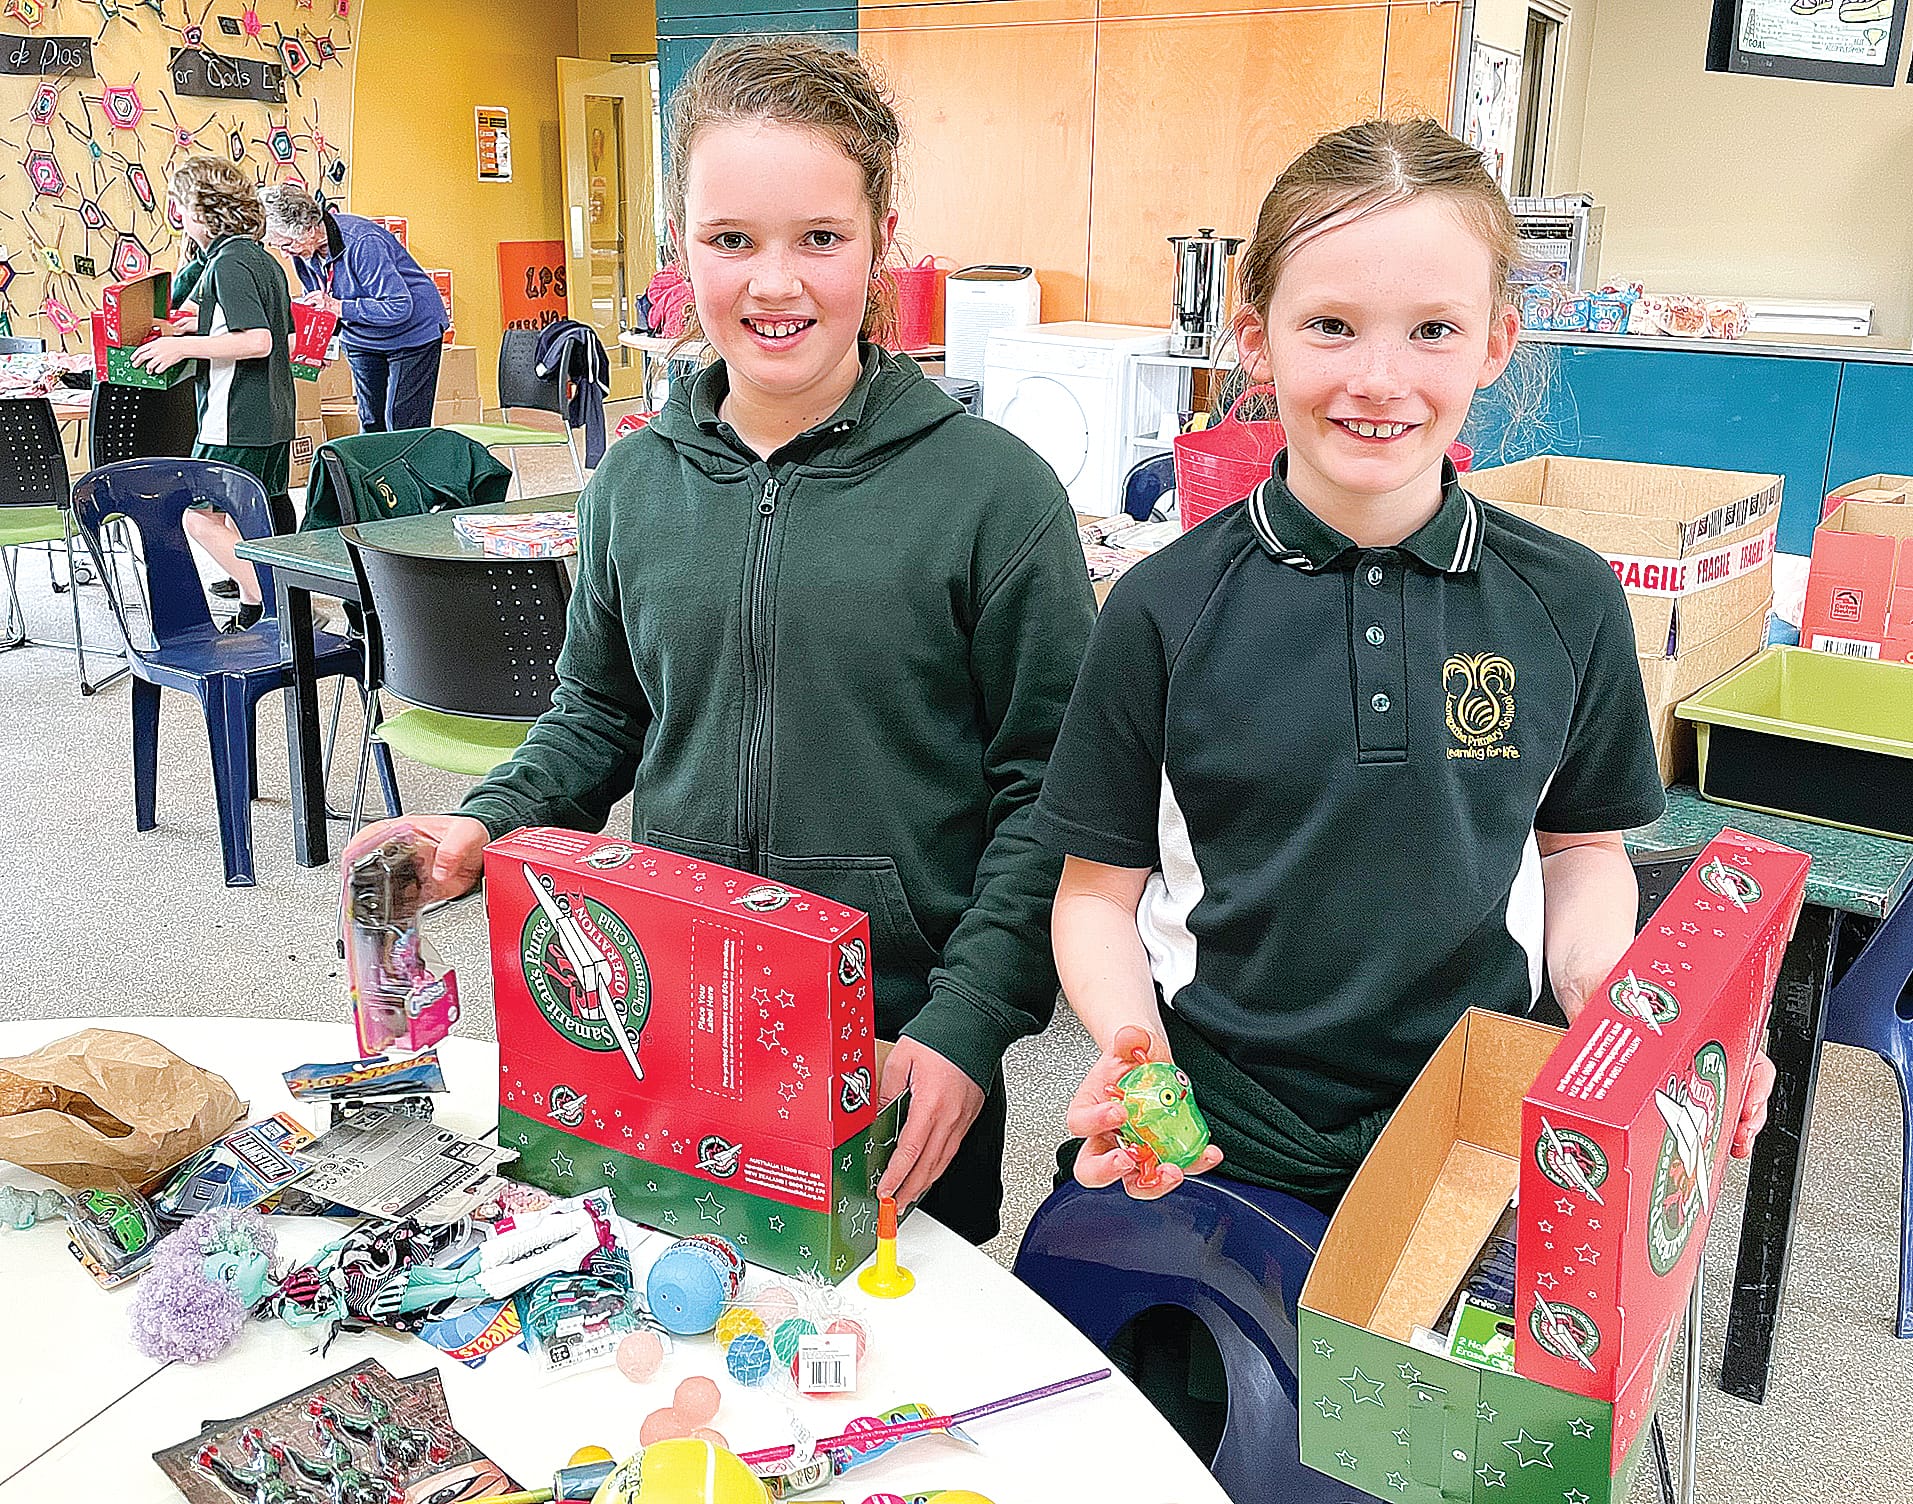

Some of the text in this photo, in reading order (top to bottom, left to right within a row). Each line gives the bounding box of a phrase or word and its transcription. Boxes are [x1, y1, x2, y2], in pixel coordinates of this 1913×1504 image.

[174, 67, 193, 84] or
[525, 266, 567, 299] LPS
[1607, 559, 1687, 592] RAGILE
[1697, 550, 1731, 585] FRAGILE
[1486, 745, 1503, 758] for
[523, 917, 552, 968] Purse
[574, 906, 627, 995] OPERATION
[597, 912, 648, 1017] Christmas Child
[697, 983, 707, 1031] Place Your
[705, 984, 715, 1034] Label Here
[1457, 1337, 1467, 1347] 2
